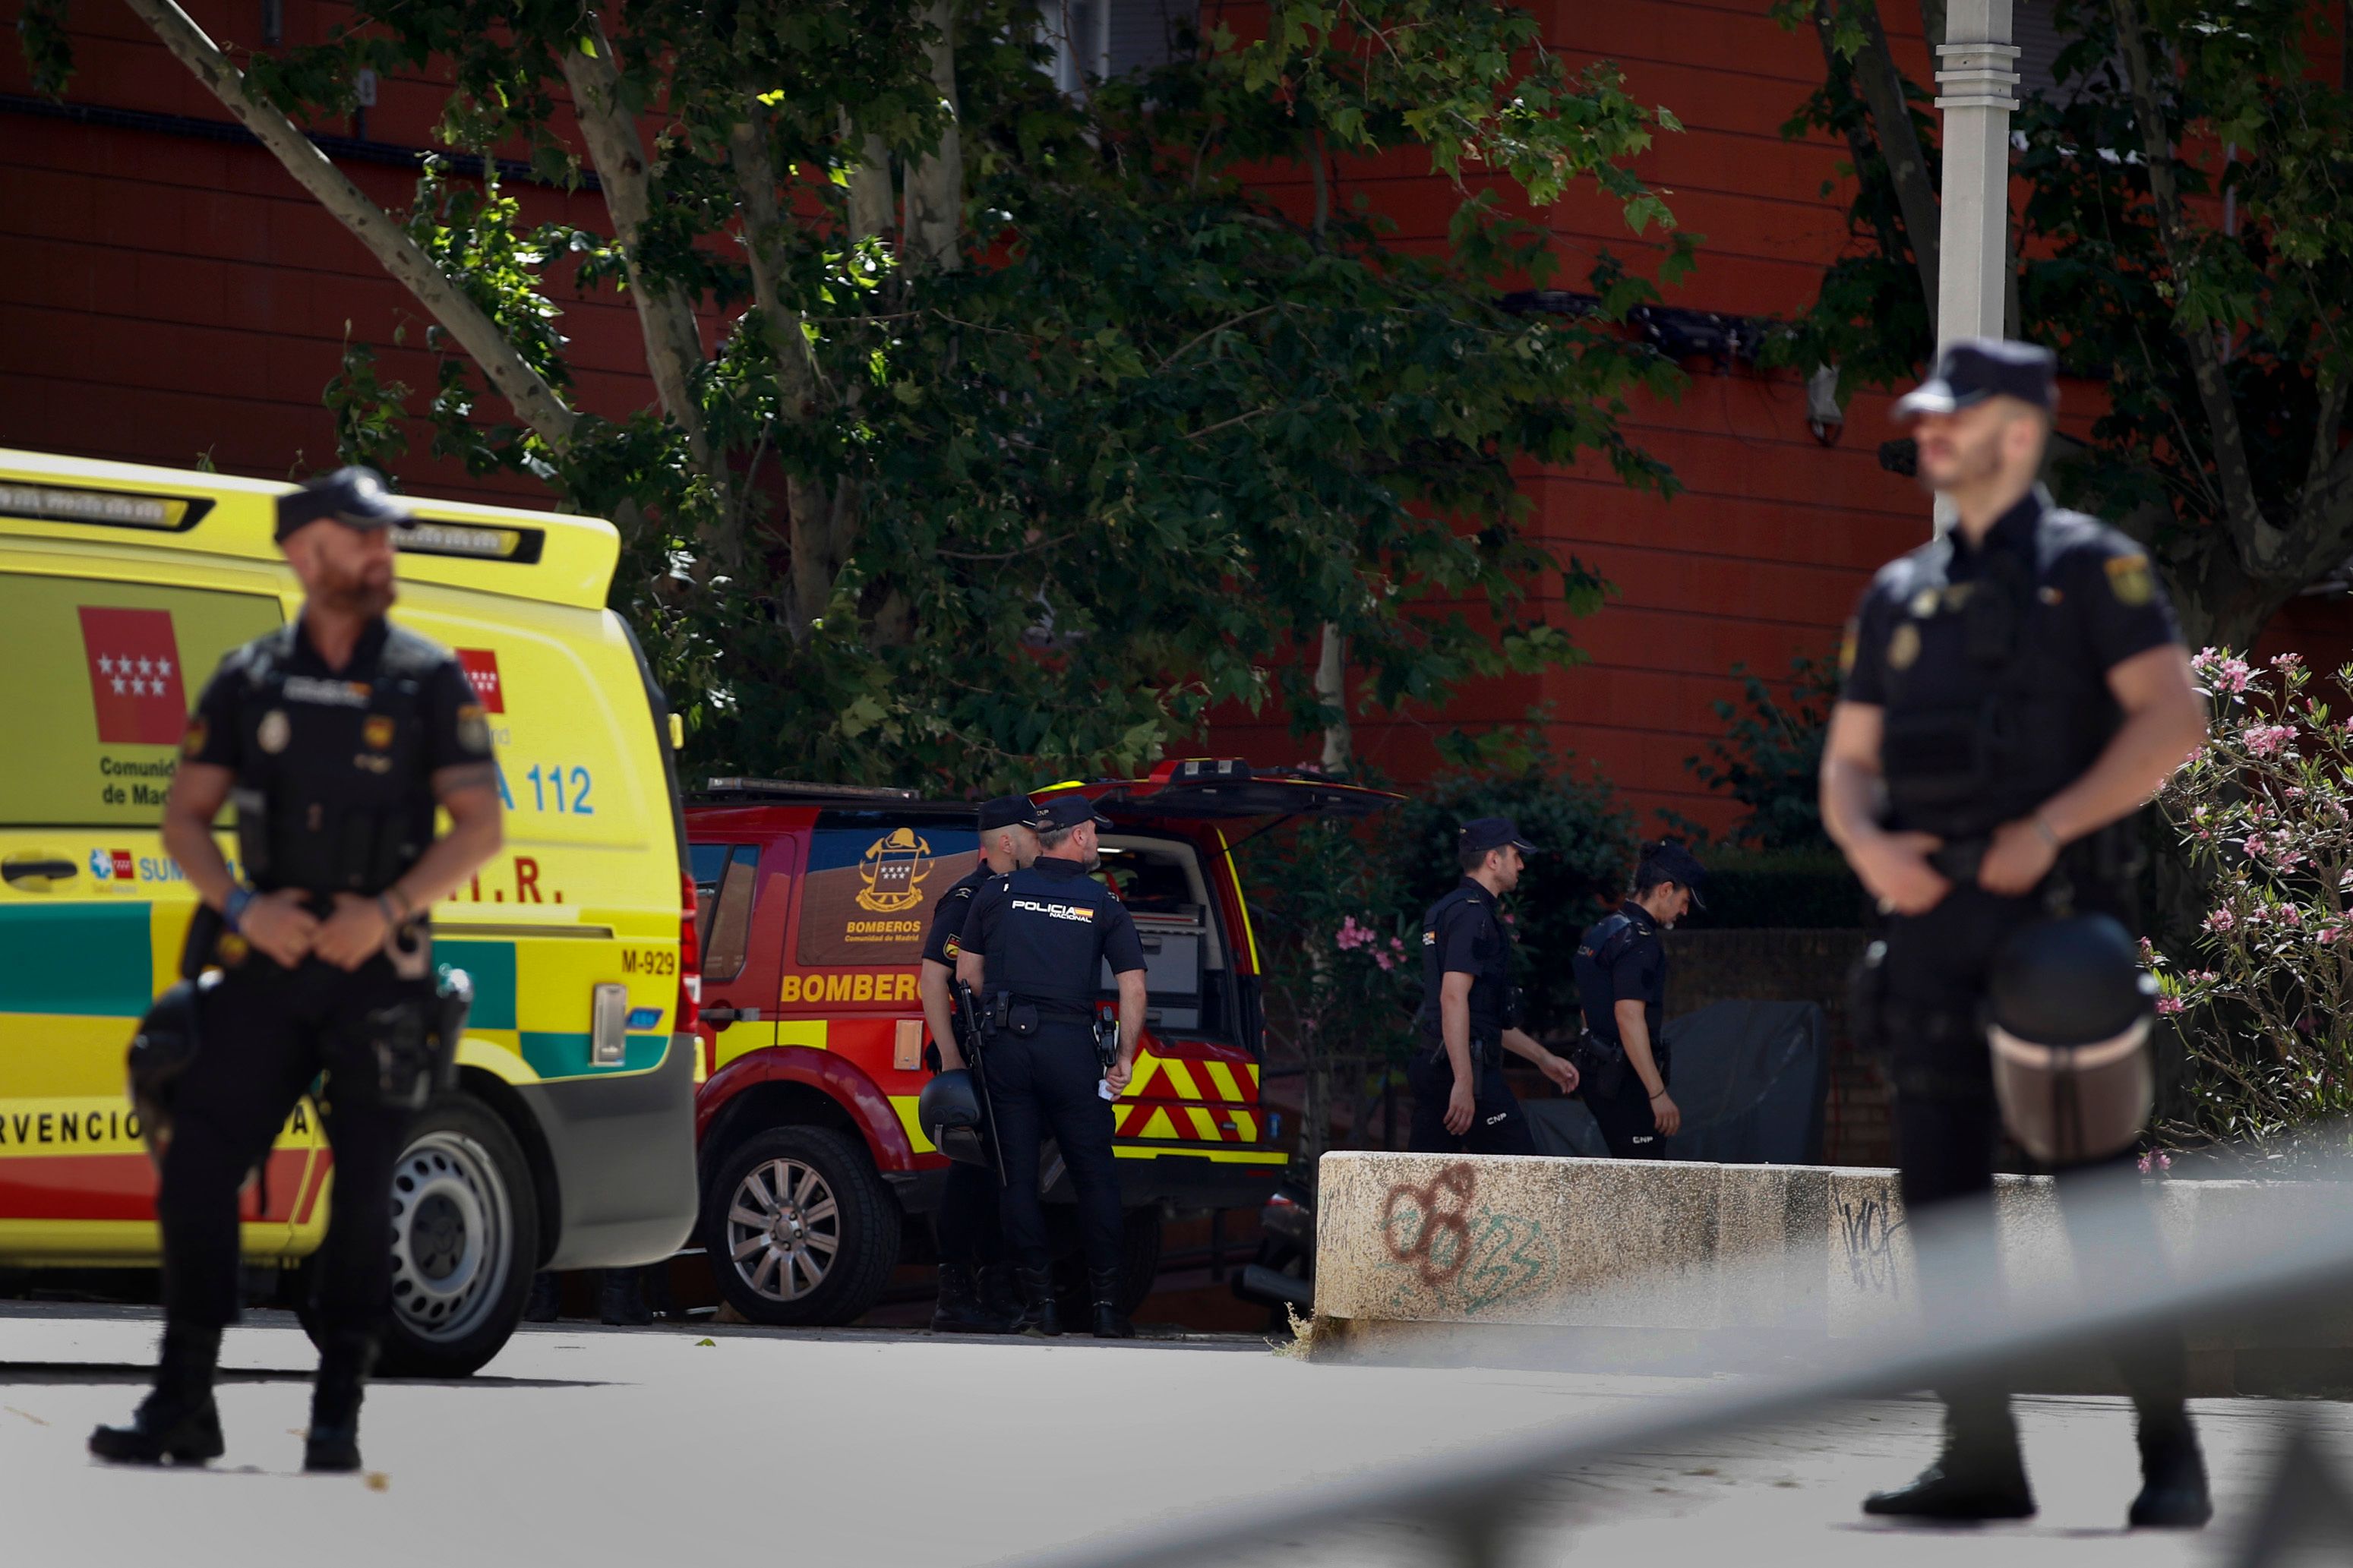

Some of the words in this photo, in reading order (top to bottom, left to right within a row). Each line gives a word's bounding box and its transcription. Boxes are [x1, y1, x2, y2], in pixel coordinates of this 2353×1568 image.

[102, 782, 127, 803] de
[526, 763, 595, 815] 112
[1012, 900, 1076, 916] POLICIA
[1049, 912, 1092, 923] NACIONAL
[846, 920, 921, 933] BOMBEROS
[621, 950, 675, 976] M-929
[781, 973, 922, 1002] BOMBER
[1486, 1112, 1508, 1125] CNP
[1632, 1136, 1653, 1144] CNP
